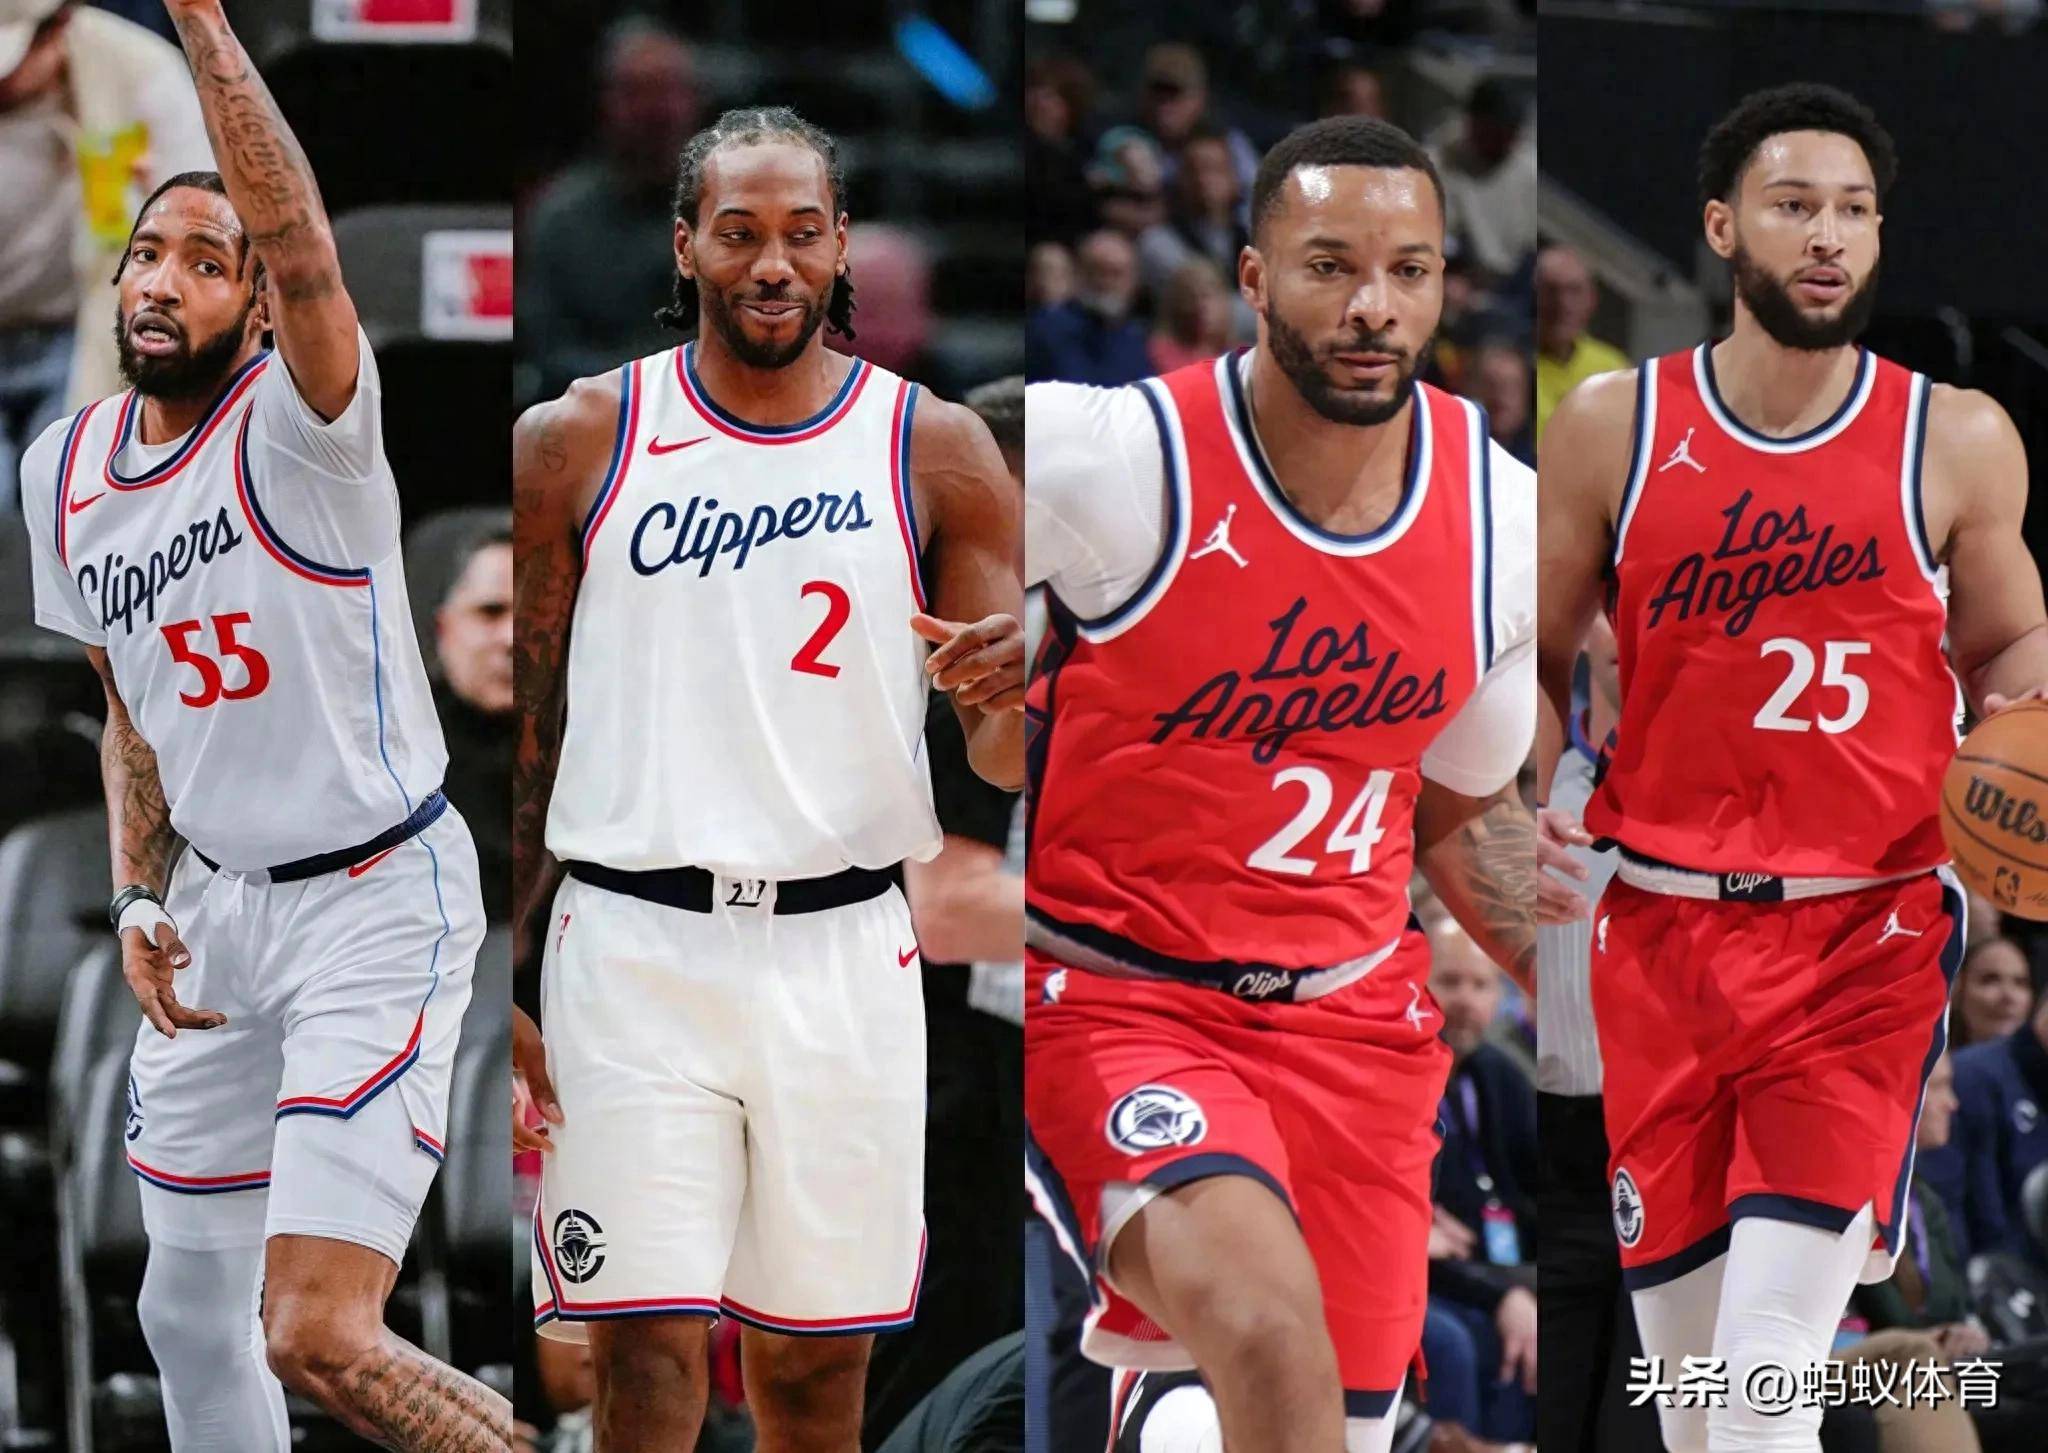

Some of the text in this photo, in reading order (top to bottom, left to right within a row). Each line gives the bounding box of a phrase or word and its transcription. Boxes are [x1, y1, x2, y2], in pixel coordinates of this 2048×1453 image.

[627, 490, 873, 578] Clippers
[1712, 489, 1816, 561] Los
[1646, 525, 1887, 637] Angeles
[159, 612, 270, 708] 55
[791, 580, 851, 679] 2
[1250, 596, 1377, 683] Los
[1149, 651, 1449, 765] Angeles
[1752, 637, 1872, 734] 25
[1246, 766, 1395, 876] 24
[1965, 776, 2048, 844] Wils
[1233, 970, 1291, 999] Clips
